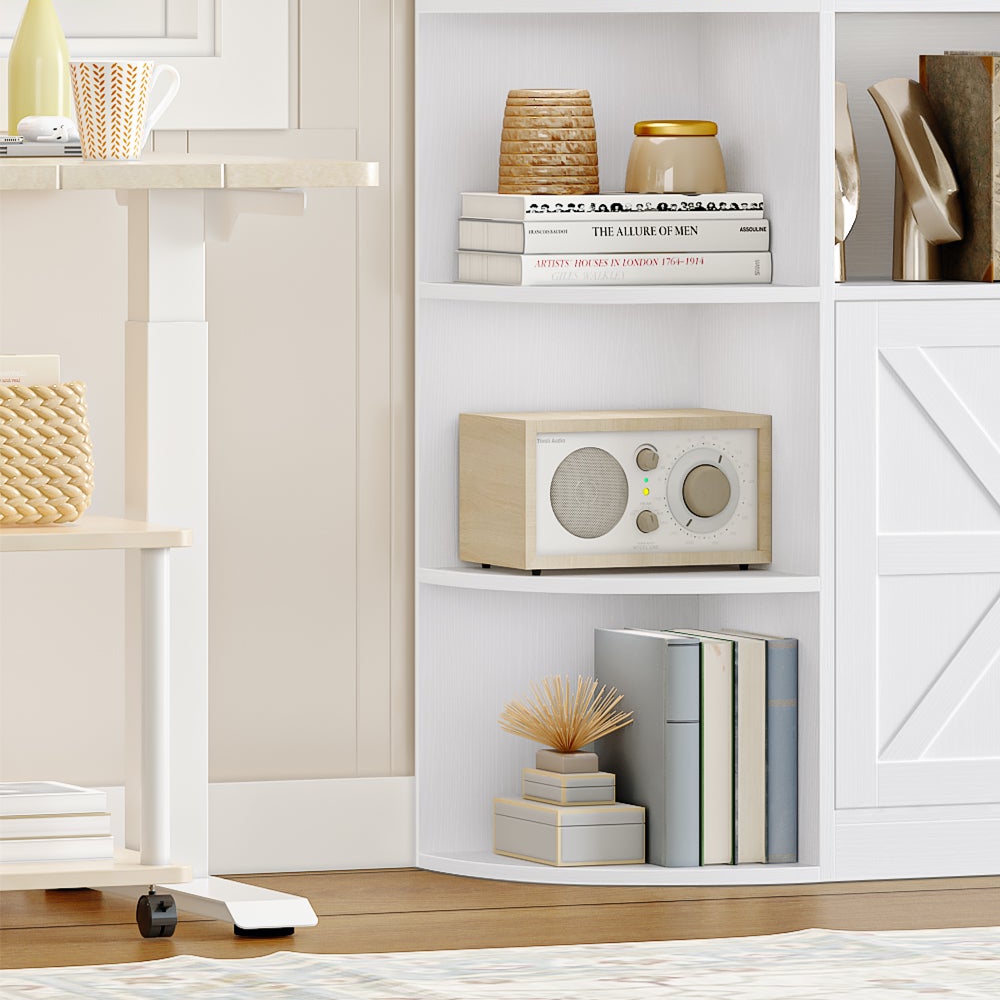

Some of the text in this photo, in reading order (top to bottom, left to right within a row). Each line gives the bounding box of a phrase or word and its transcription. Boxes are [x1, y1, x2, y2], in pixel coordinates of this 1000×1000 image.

[592, 225, 698, 237] THE ALLURE OF MEN
[573, 258, 609, 268] HOUSES
[610, 258, 620, 267] IN
[622, 258, 659, 267] LONDON
